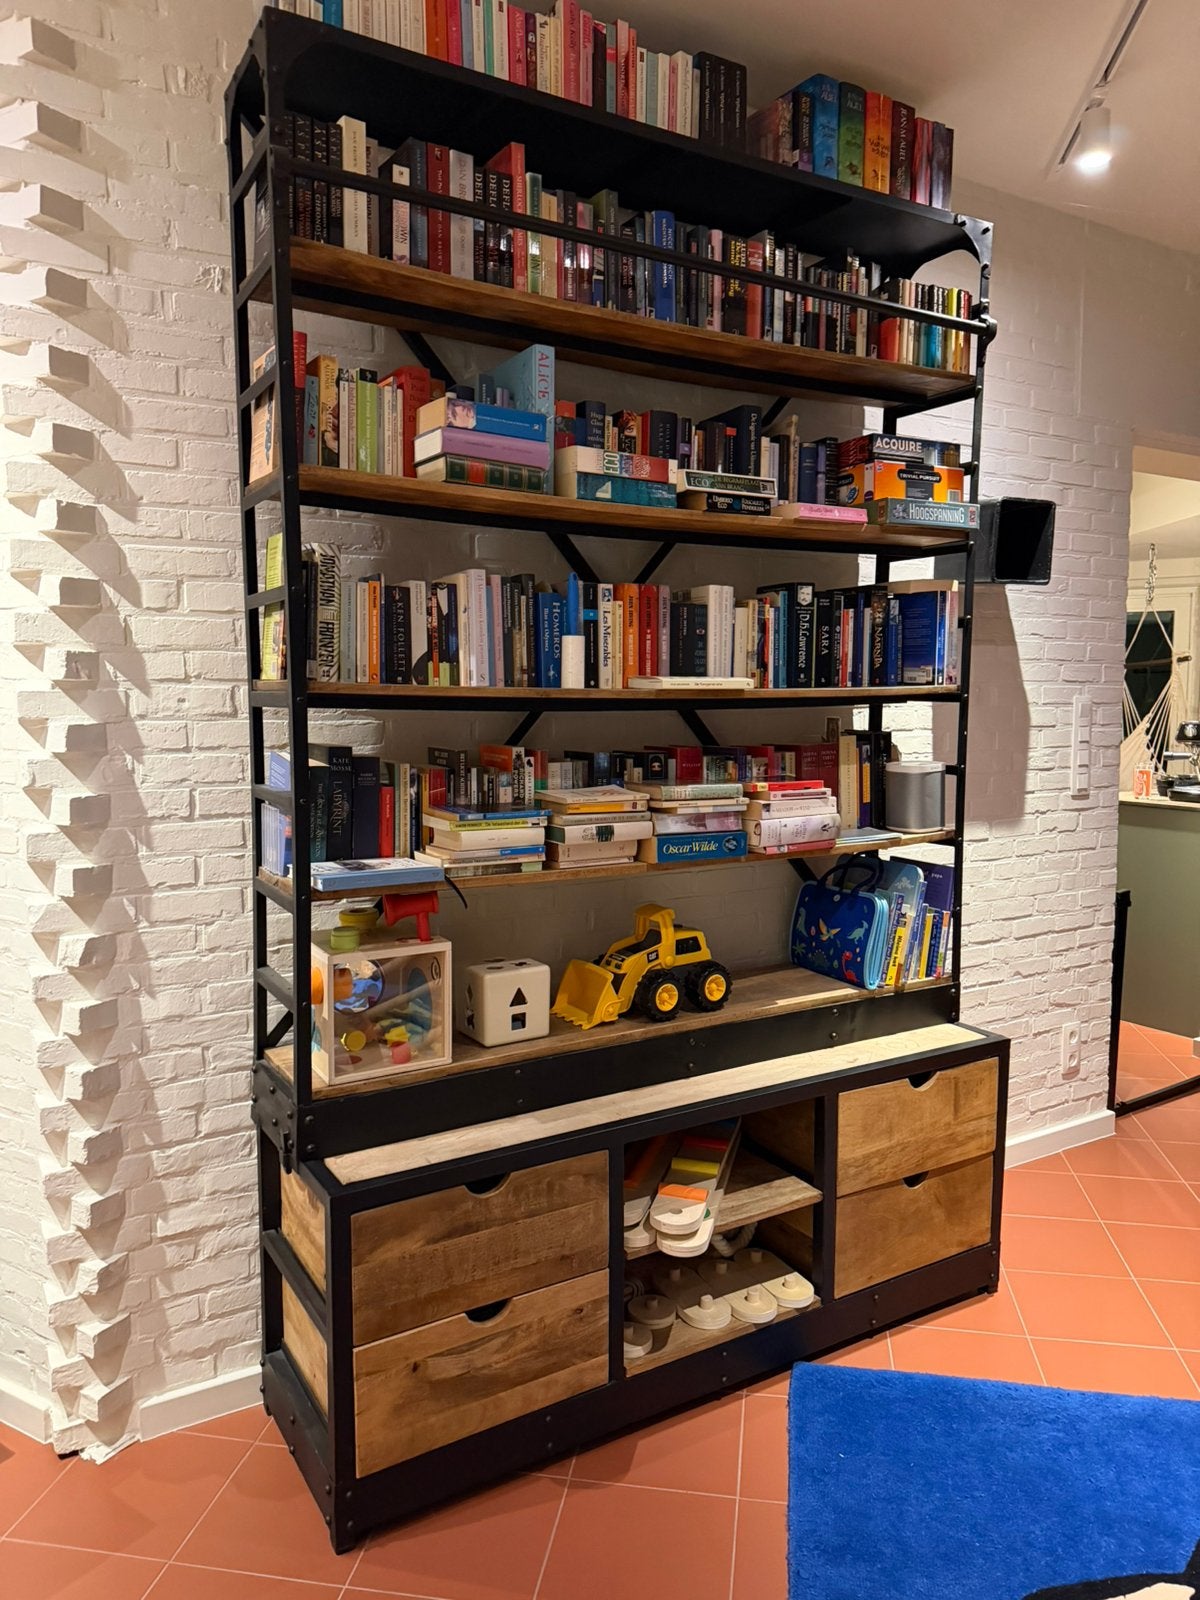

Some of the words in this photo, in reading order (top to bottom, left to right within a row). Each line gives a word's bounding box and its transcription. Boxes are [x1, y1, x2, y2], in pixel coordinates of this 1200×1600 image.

[874, 437, 922, 453] ACQUIRE
[603, 452, 620, 474] ECO
[690, 478, 709, 487] ECO
[908, 503, 965, 523] HOOGSPANNING
[319, 553, 336, 607] JONATHAN
[397, 602, 405, 622] KEN
[318, 621, 336, 668] FRANZEN
[553, 602, 561, 658] HOMEROS
[821, 625, 830, 655] SARA
[397, 628, 406, 672] FOLLETT
[603, 625, 611, 667] Misérables
[873, 626, 883, 669] NARNIA
[331, 781, 342, 837] LABYRINT
[663, 843, 692, 855] Oscar
[691, 840, 719, 852] Wilde
[894, 935, 903, 955] Kleine
